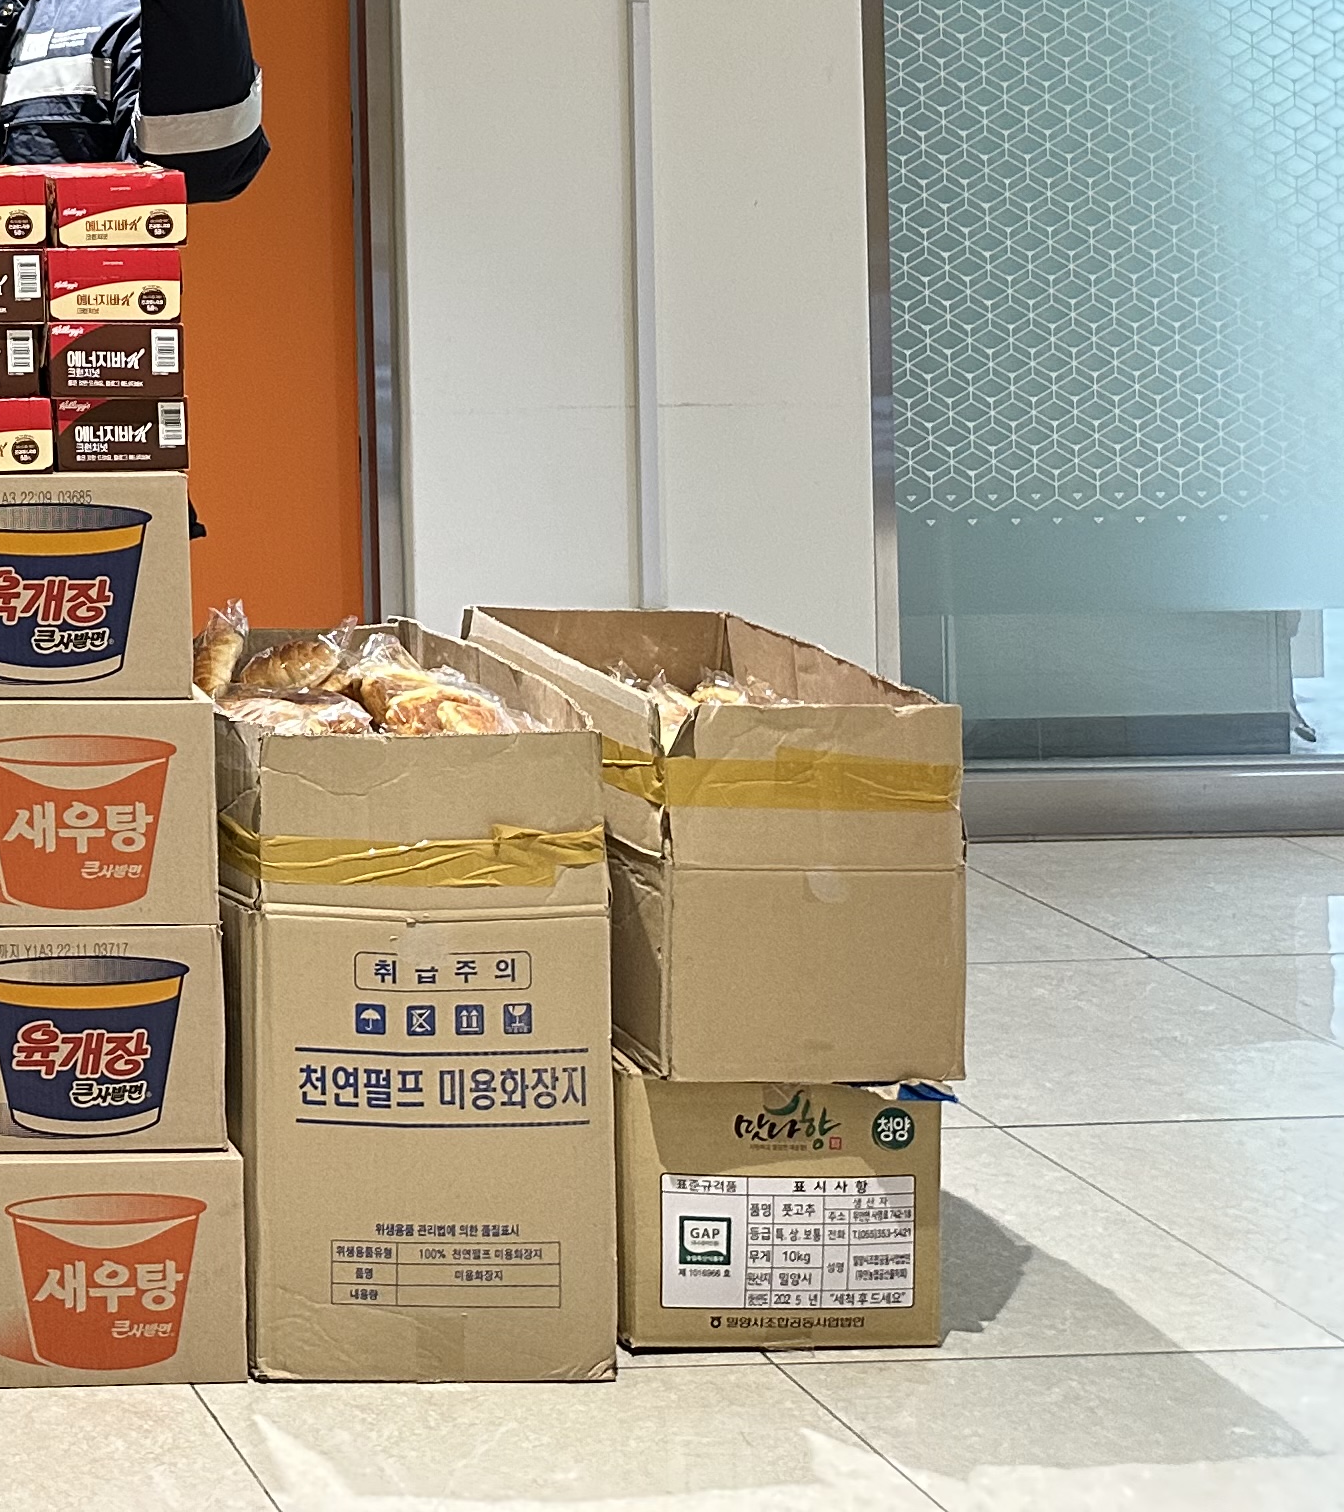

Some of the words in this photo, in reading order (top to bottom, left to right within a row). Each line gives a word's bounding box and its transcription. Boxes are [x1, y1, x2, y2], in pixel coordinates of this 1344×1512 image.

[31, 627, 109, 654] 큰사발면
[2, 800, 154, 855] 새우탕
[80, 859, 146, 880] 큰사발면
[11, 1019, 152, 1079] 육개장
[69, 1080, 148, 1107] 큰사발면
[297, 1064, 424, 1109] 천연펄프
[438, 1065, 588, 1112] 미용화장지
[876, 1115, 912, 1142] 청양
[690, 1227, 721, 1240] GAP
[418, 1248, 447, 1260] 100%
[748, 1249, 771, 1263] 무게
[781, 1250, 812, 1264] 10kg
[32, 1257, 185, 1313] 새우탕
[109, 1319, 175, 1339] 큰사발면
